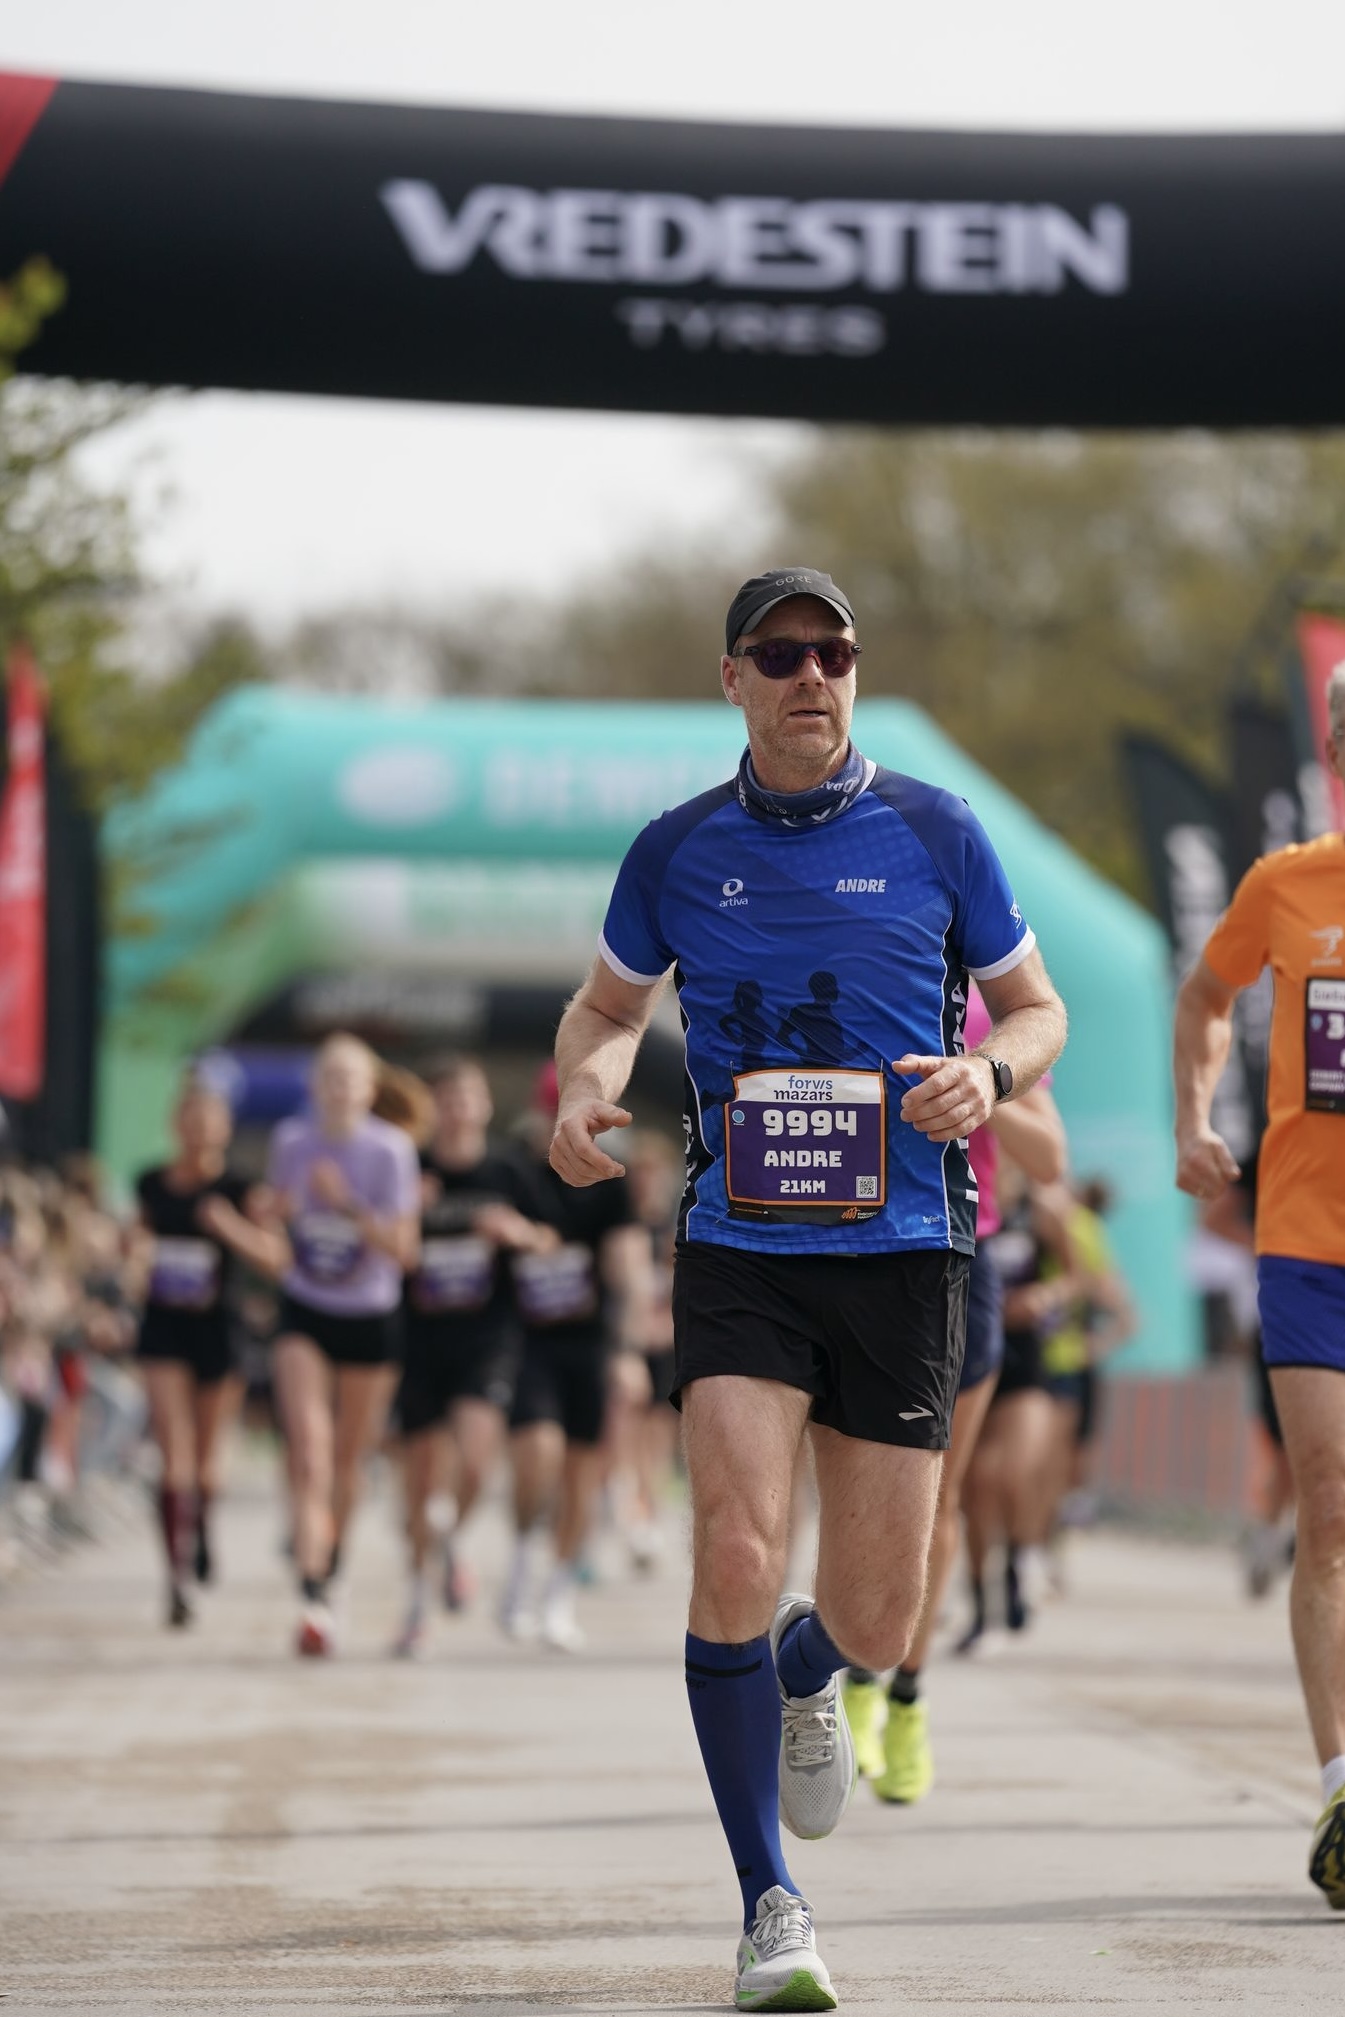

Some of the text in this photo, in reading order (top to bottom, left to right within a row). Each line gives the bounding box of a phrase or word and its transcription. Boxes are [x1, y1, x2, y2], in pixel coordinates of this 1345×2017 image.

[382, 179, 1129, 293] VREDESTEIN
[620, 300, 886, 356] TYRES
[775, 575, 812, 586] GORE
[835, 878, 886, 893] ANDRE
[719, 897, 748, 908] artiva
[774, 1090, 833, 1101] mazars
[763, 1109, 857, 1136] 9994
[764, 1150, 842, 1168] ANDRE
[780, 1180, 826, 1194] 21KM
